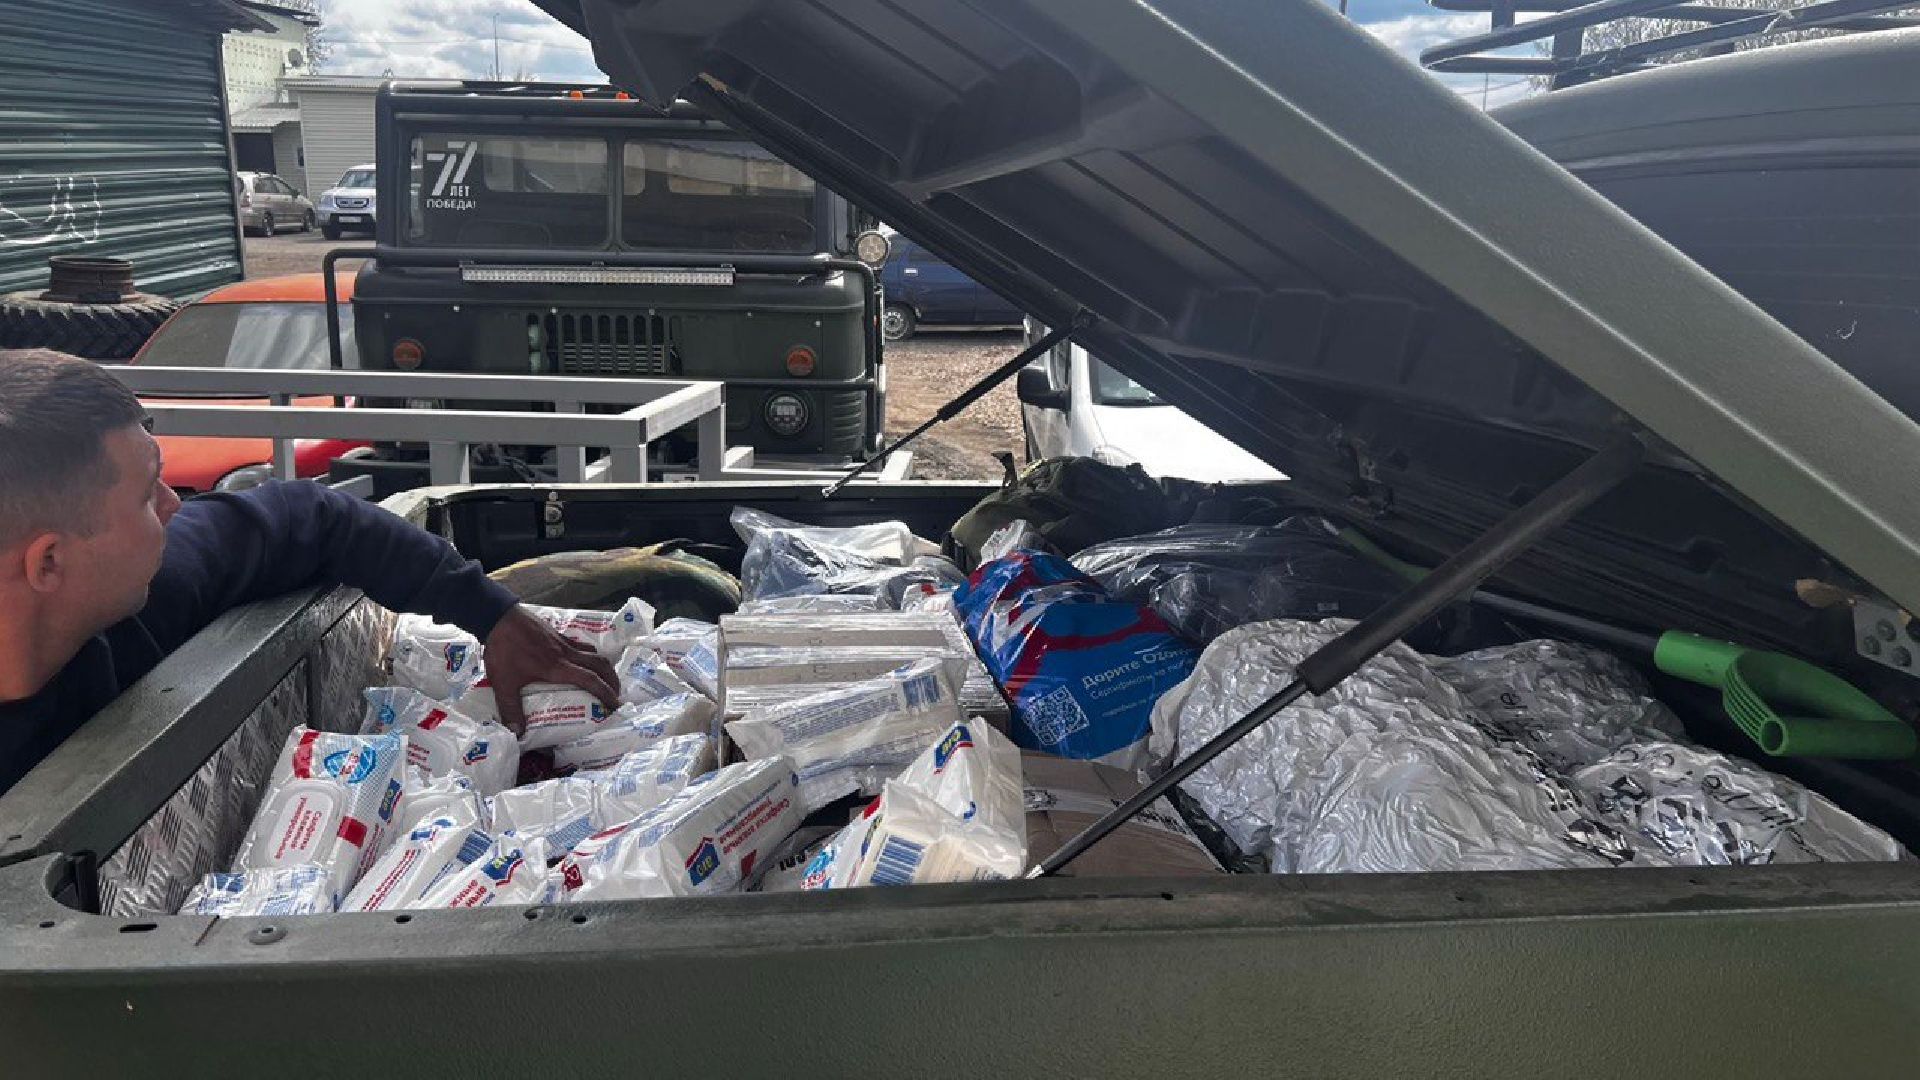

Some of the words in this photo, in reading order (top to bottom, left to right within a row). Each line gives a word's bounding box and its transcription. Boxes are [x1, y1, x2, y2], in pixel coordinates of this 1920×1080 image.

[427, 141, 478, 196] 77
[450, 185, 470, 197] ЛЕТ
[426, 199, 476, 211] ПОБЕДА!
